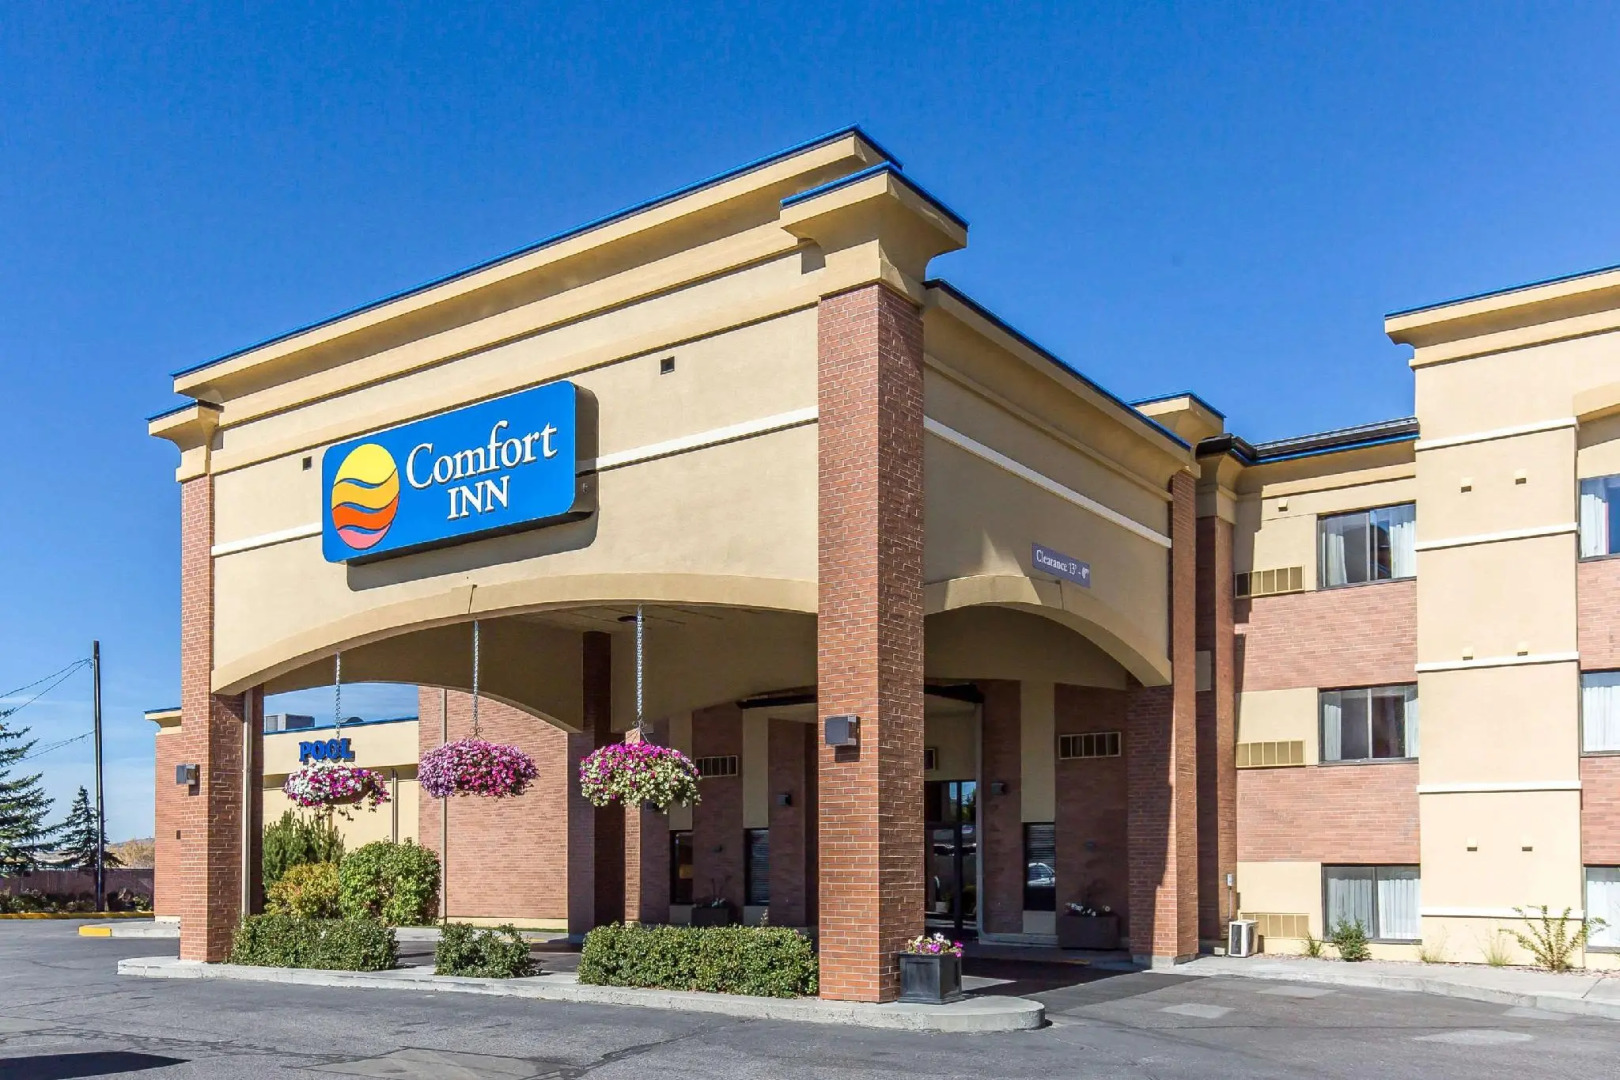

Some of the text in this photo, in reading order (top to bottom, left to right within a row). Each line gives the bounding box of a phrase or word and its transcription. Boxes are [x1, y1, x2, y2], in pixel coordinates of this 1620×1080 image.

[406, 420, 558, 489] Comfort
[447, 475, 510, 520] INN
[1036, 549, 1068, 572] Clearance
[299, 738, 354, 763] POOL
